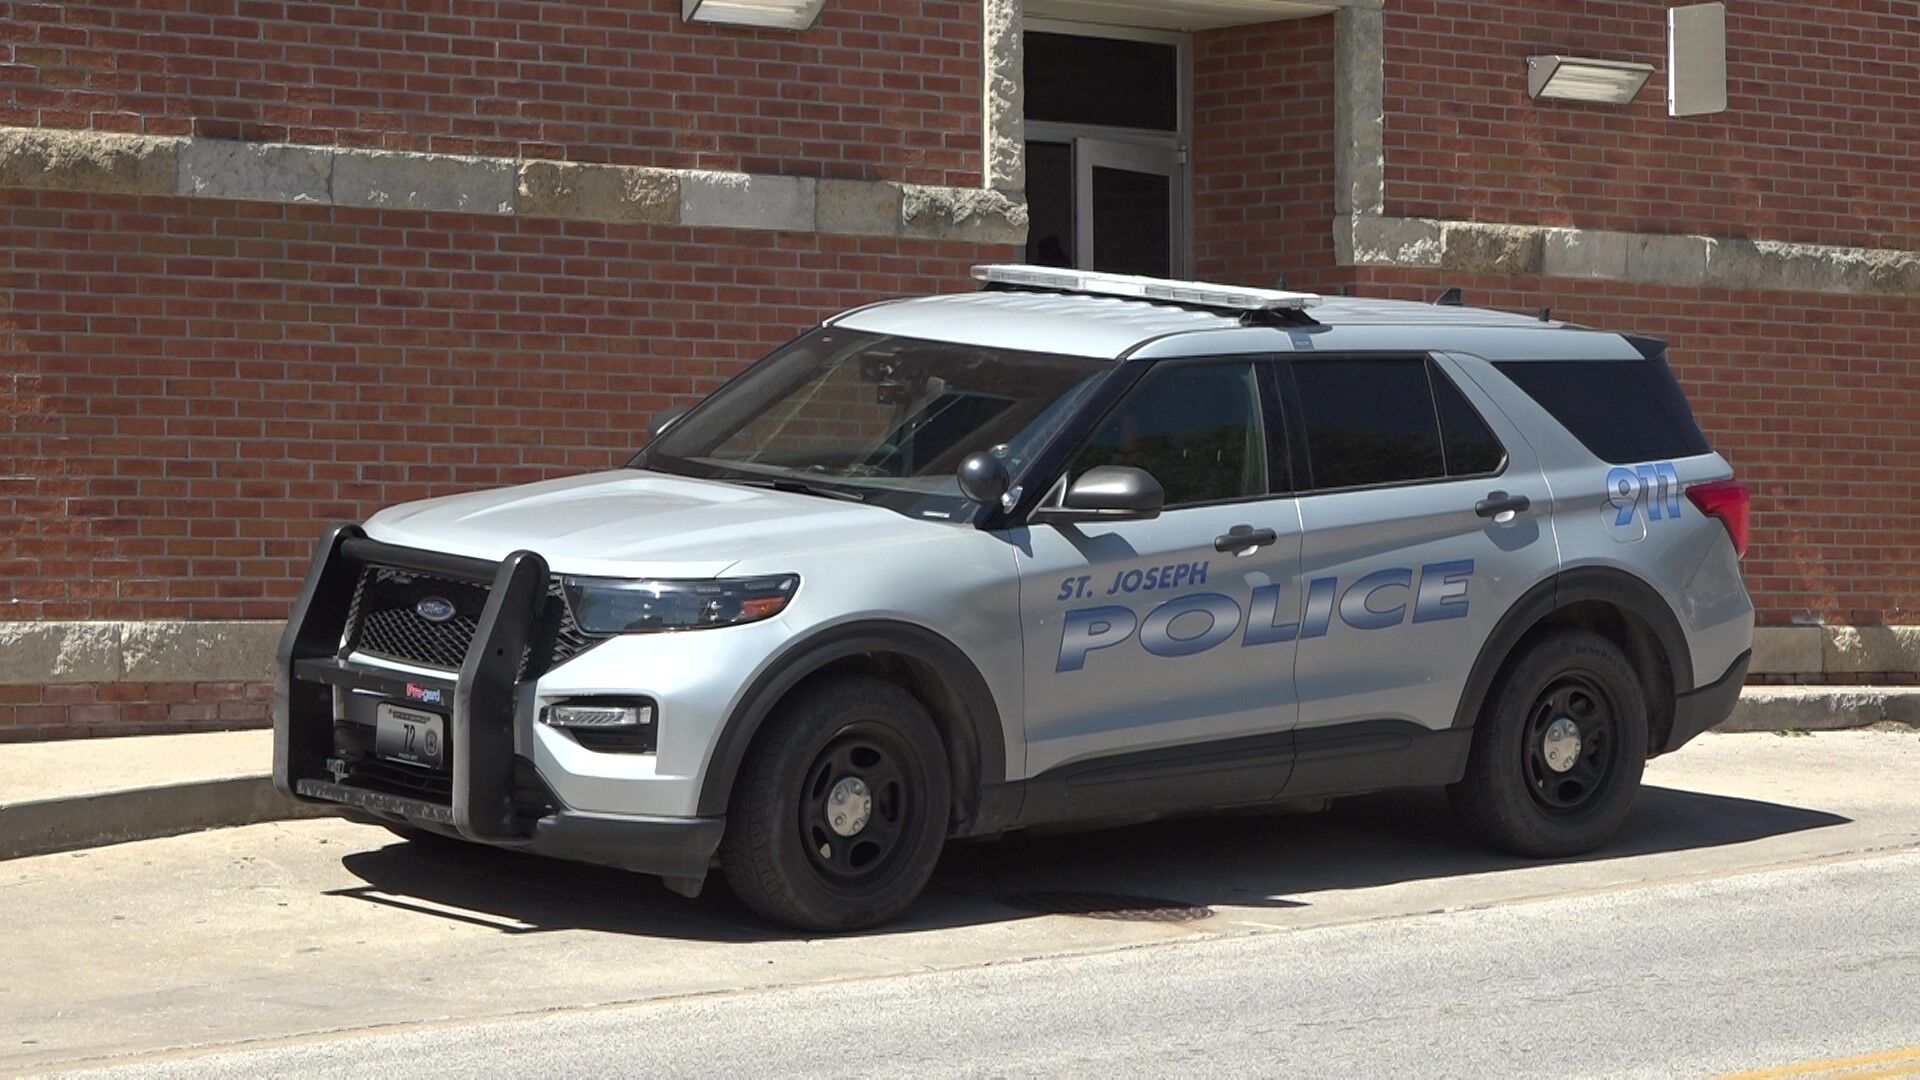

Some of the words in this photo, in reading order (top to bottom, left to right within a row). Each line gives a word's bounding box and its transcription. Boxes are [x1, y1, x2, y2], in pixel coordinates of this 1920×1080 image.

[1606, 461, 1682, 527] 911
[1057, 575, 1094, 602] ST.
[1107, 560, 1210, 597] JOSEPH
[1054, 558, 1475, 674] POLICE
[403, 723, 416, 753] 72
